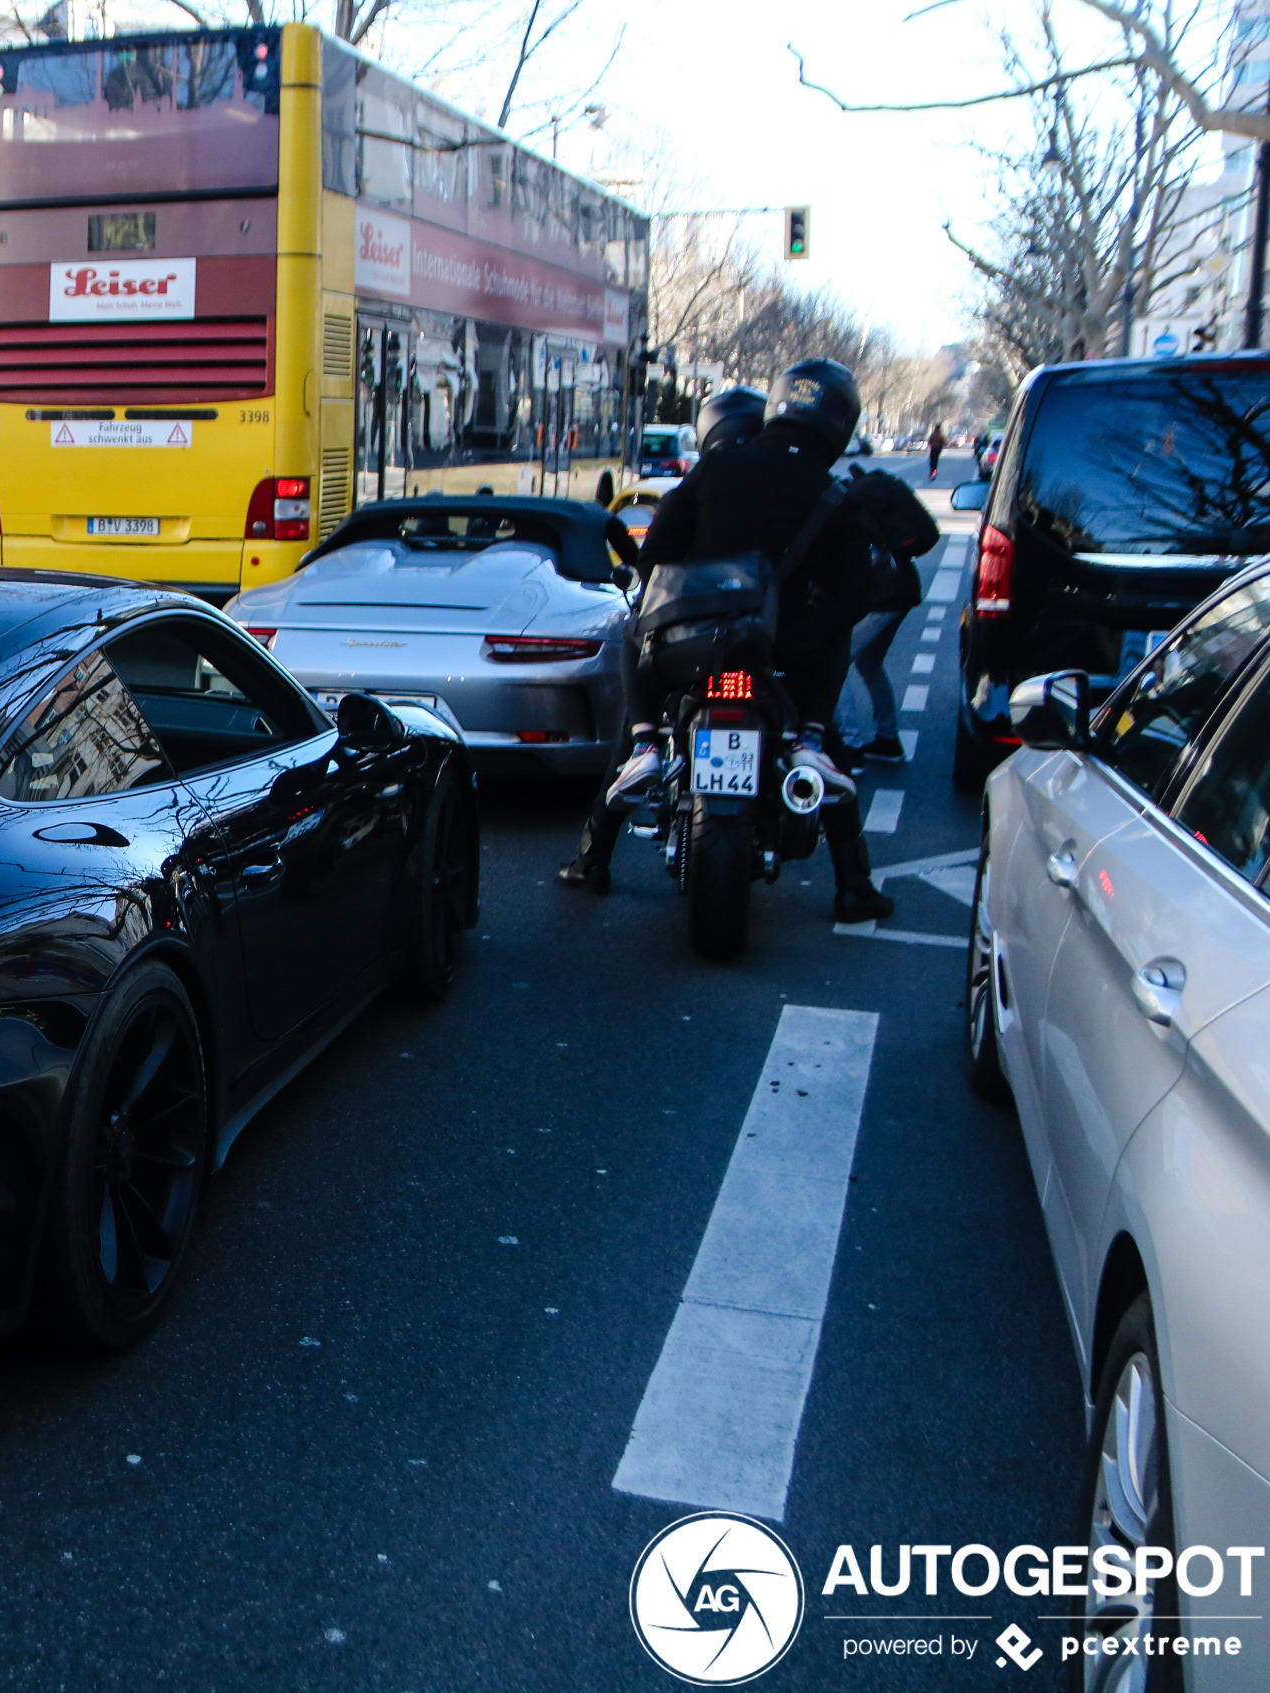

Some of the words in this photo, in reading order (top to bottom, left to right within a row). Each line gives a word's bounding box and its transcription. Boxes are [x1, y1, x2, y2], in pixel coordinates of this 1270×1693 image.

[360, 220, 404, 268] Leiser
[412, 240, 481, 292] Internationale
[64, 267, 177, 297] Leiser
[240, 409, 270, 423] 3398
[99, 421, 142, 433] Fahrzeug
[88, 433, 133, 443] schwenkt
[98, 519, 106, 532] B
[113, 519, 121, 532] V
[125, 519, 154, 532] 3398
[729, 733, 740, 749] B
[696, 772, 723, 791] LH
[728, 774, 753, 792] 44
